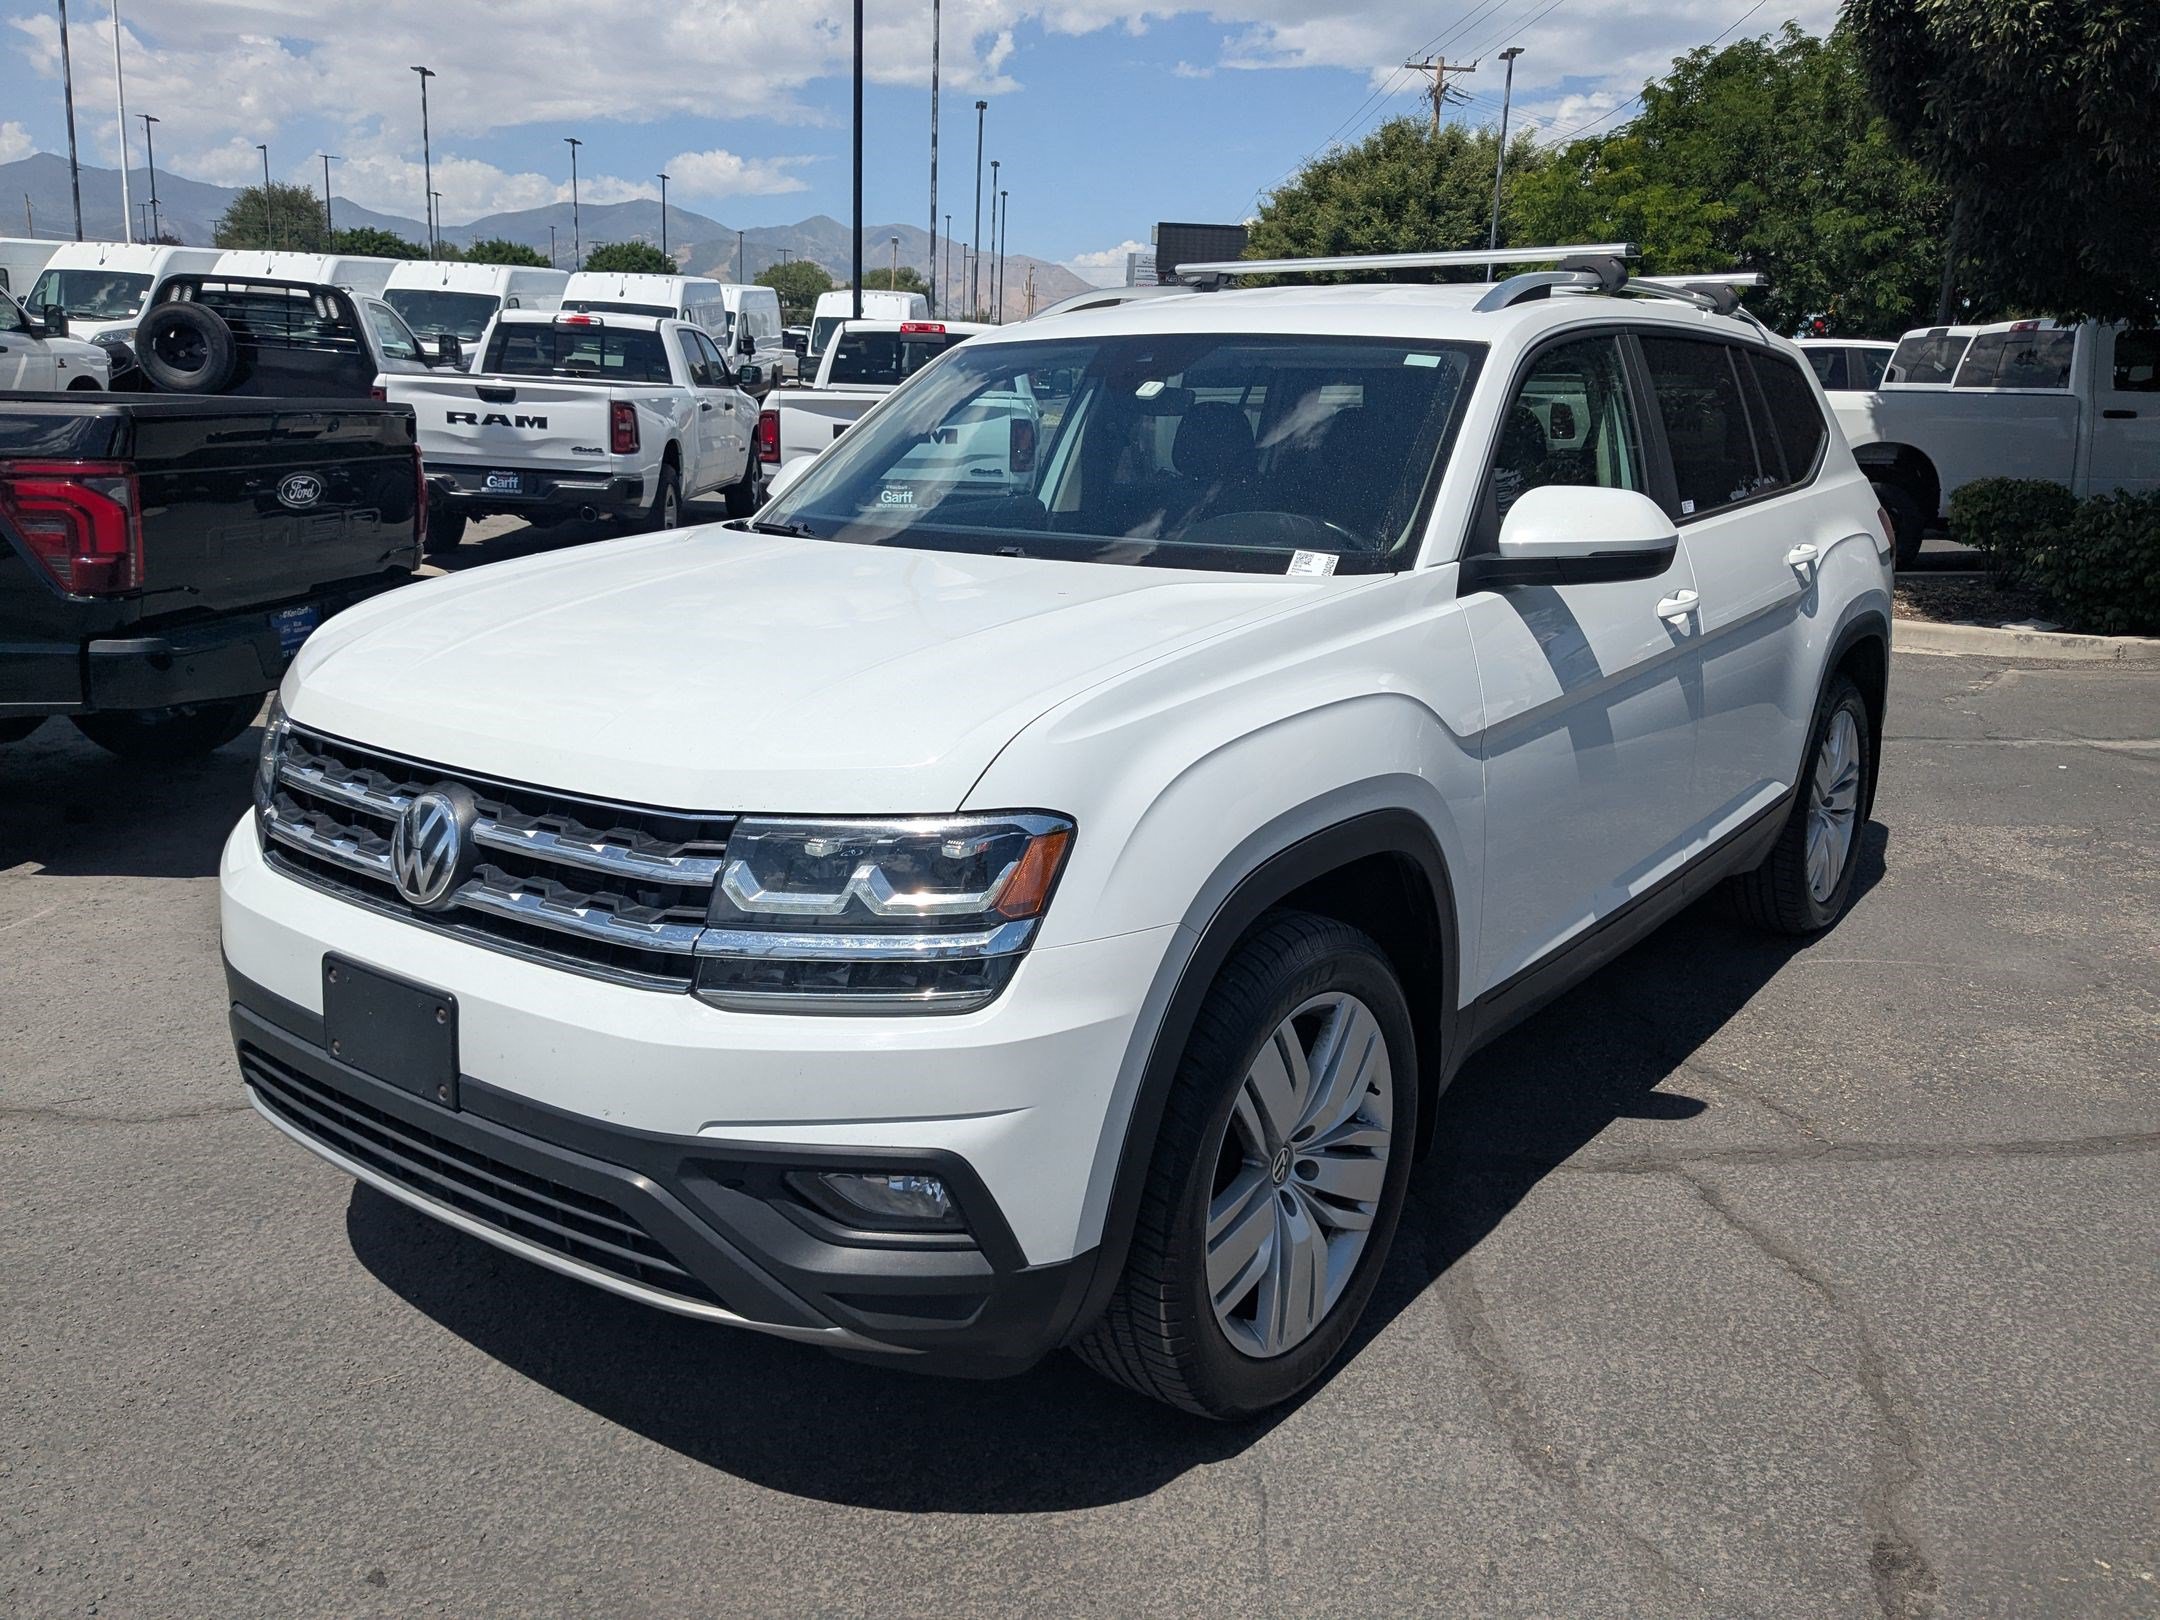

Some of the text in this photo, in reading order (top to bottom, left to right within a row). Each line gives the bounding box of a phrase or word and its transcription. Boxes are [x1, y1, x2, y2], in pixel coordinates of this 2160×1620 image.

[446, 411, 548, 430] RAM
[289, 480, 315, 499] Ford
[486, 475, 519, 489] Garff
[881, 490, 914, 503] Garff
[392, 793, 459, 903] VW
